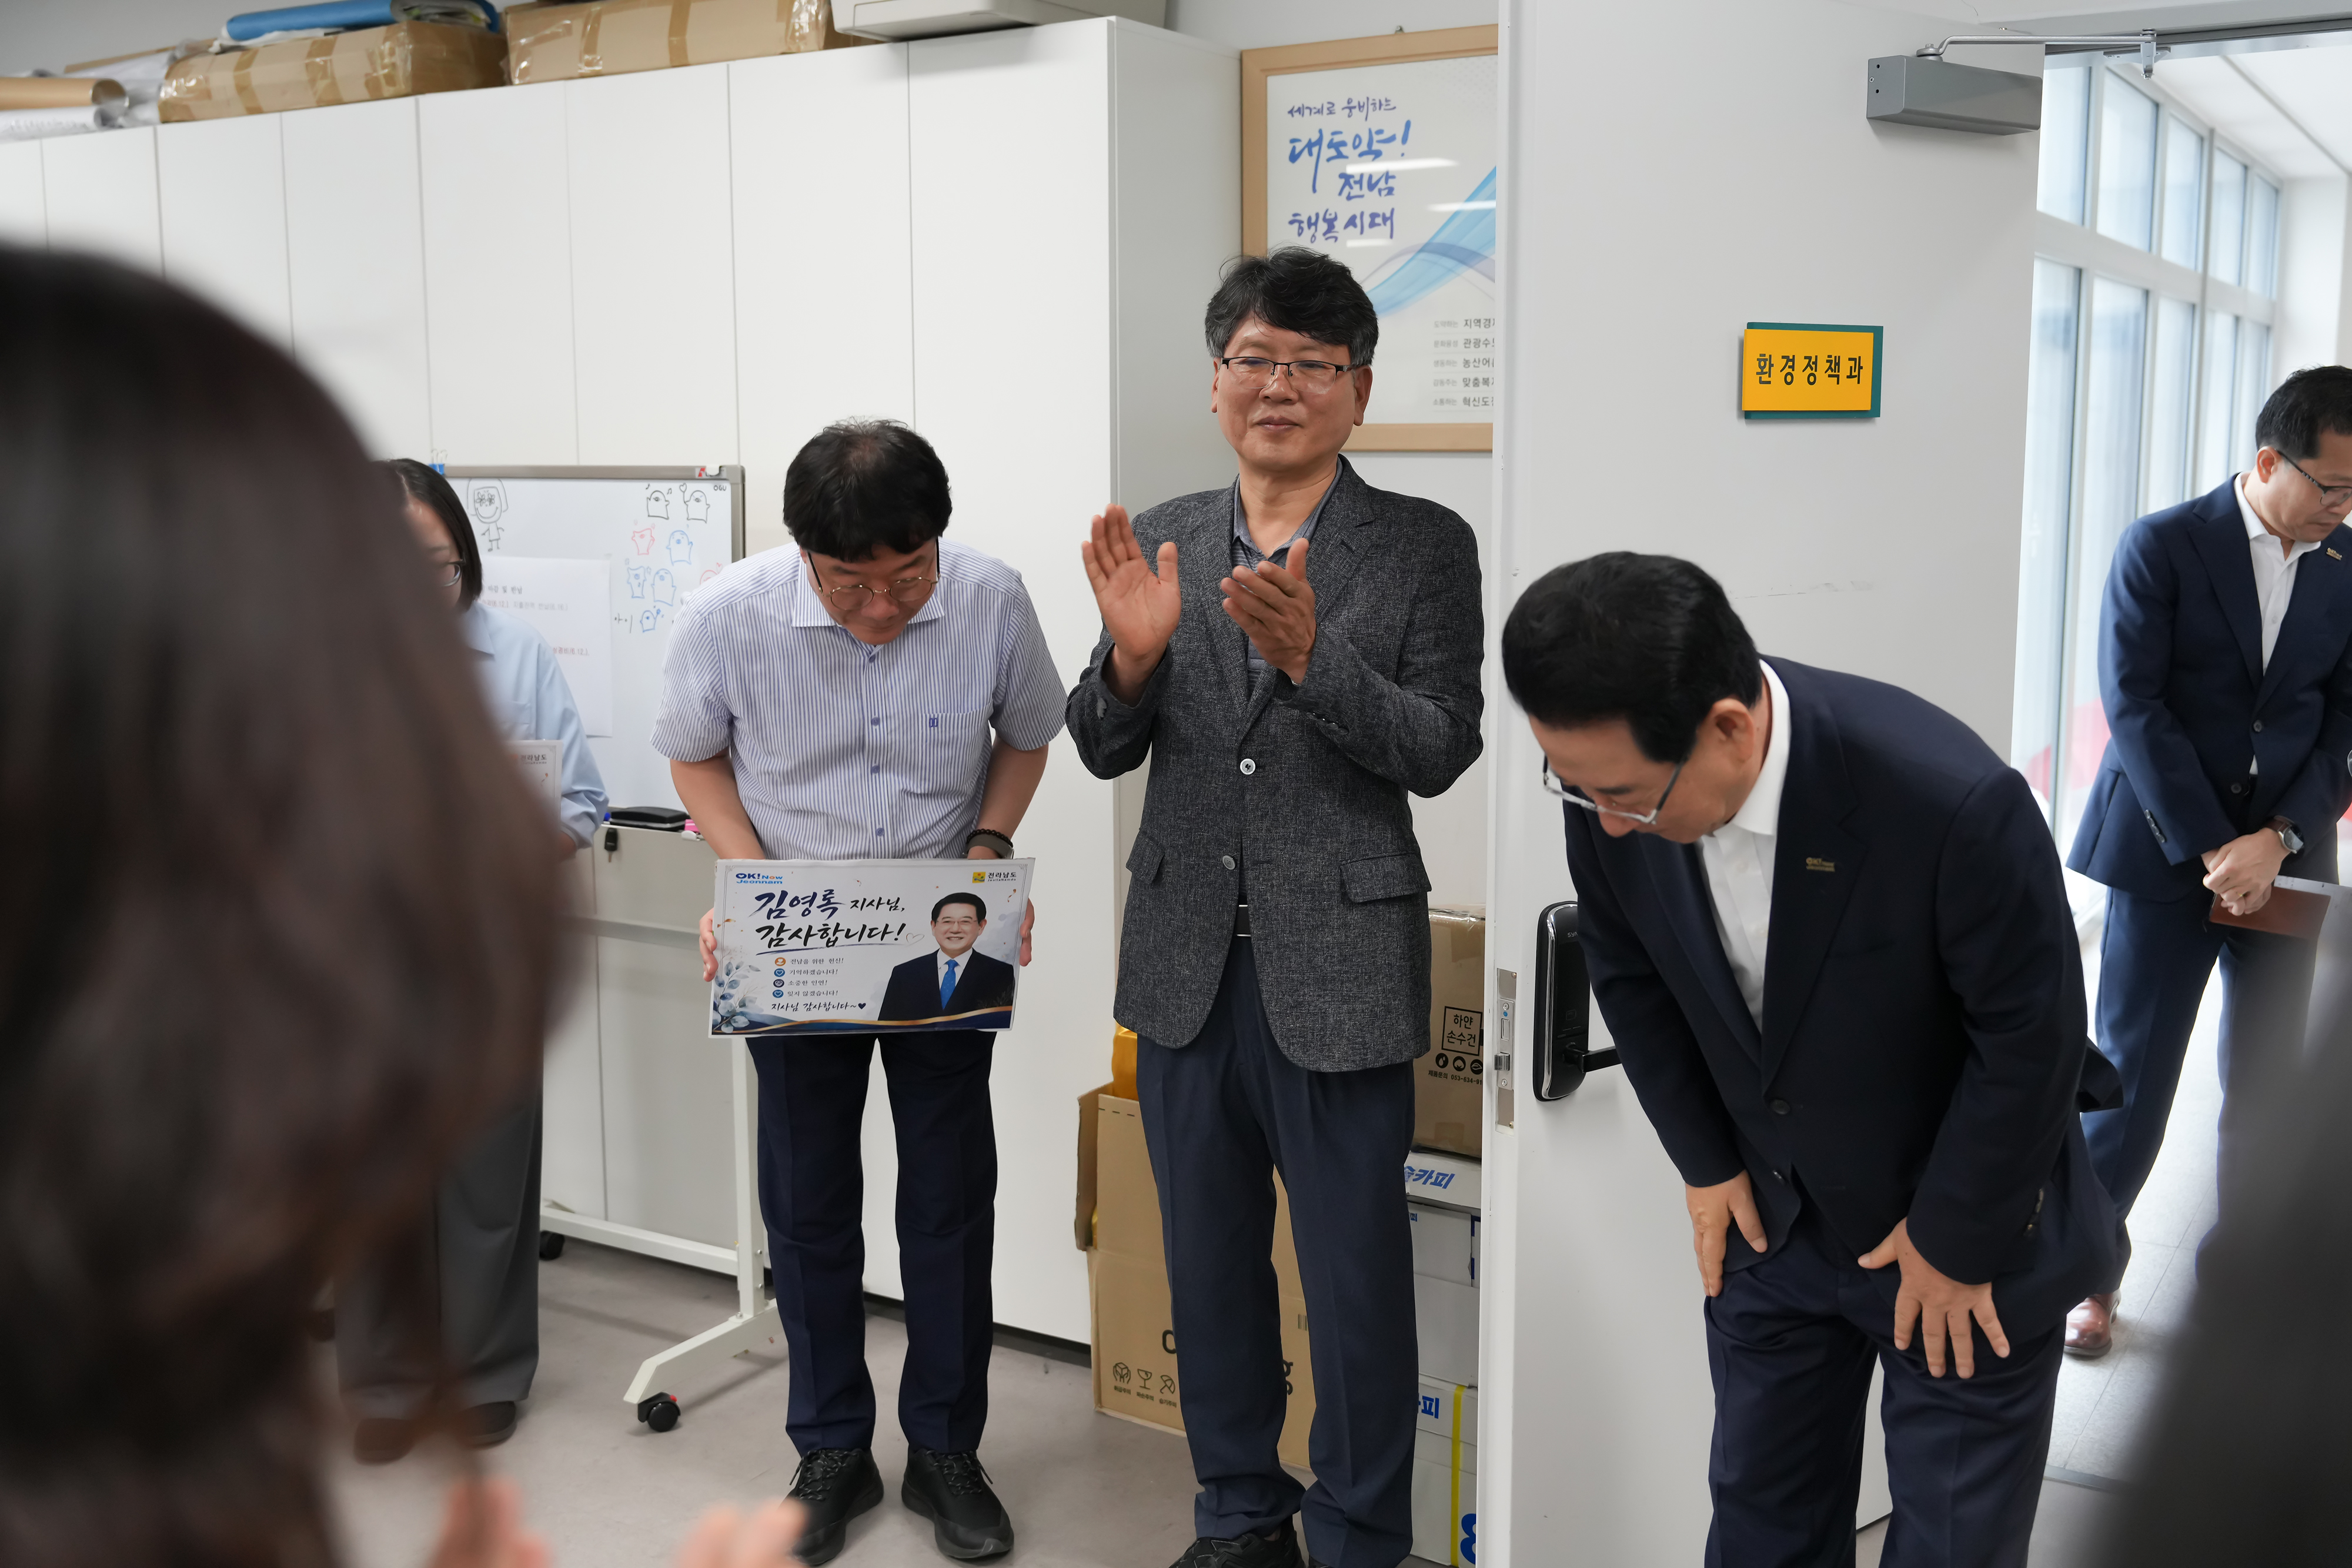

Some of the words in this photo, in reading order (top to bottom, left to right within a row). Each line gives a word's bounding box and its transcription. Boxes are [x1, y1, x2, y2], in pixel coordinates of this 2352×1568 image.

[1288, 102, 1336, 118] 세계로
[1342, 96, 1396, 121] 웅비하는
[1288, 119, 1411, 193] 대도약!
[1338, 170, 1396, 200] 전남
[1464, 318, 1495, 329] 지역경
[1462, 357, 1494, 368] 농산어
[1756, 353, 1863, 386] 환경정책과
[749, 889, 847, 920] 김영록
[850, 897, 905, 912] 지사님,
[755, 922, 906, 948] 감사합니다!
[771, 1002, 799, 1012] 지사님
[1454, 1014, 1474, 1029] 하얀
[1446, 1030, 1476, 1048] 손수건
[1428, 1070, 1448, 1079] 제품문의
